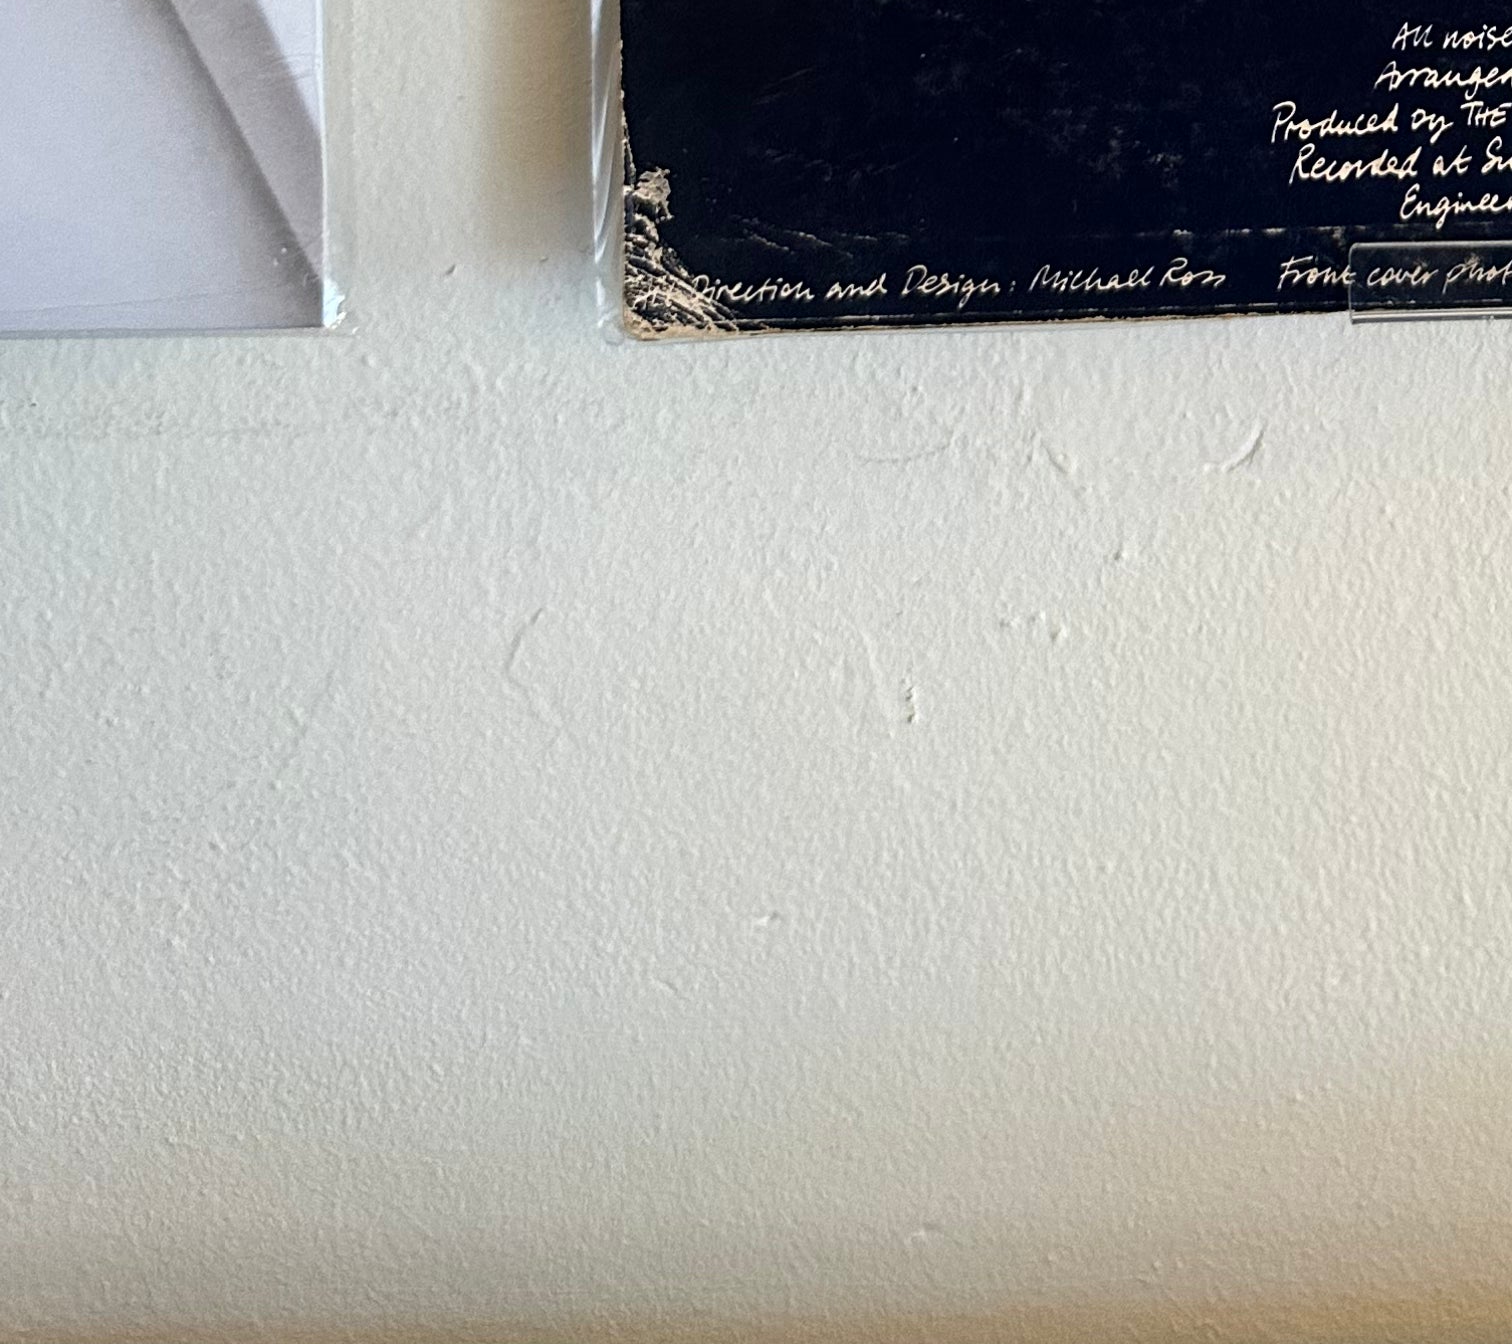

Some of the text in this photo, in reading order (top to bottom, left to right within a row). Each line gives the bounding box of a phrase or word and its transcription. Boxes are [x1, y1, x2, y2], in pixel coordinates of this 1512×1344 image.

[1391, 22, 1434, 51] All
[1271, 100, 1400, 143] Produced
[1410, 108, 1454, 144] by
[1460, 100, 1512, 127] THE
[1288, 143, 1423, 184] Recorded
[1432, 145, 1473, 177] at
[825, 272, 888, 302] and
[1028, 264, 1155, 292] Michael
[1276, 255, 1356, 291] Front
[1366, 268, 1440, 287] cover
